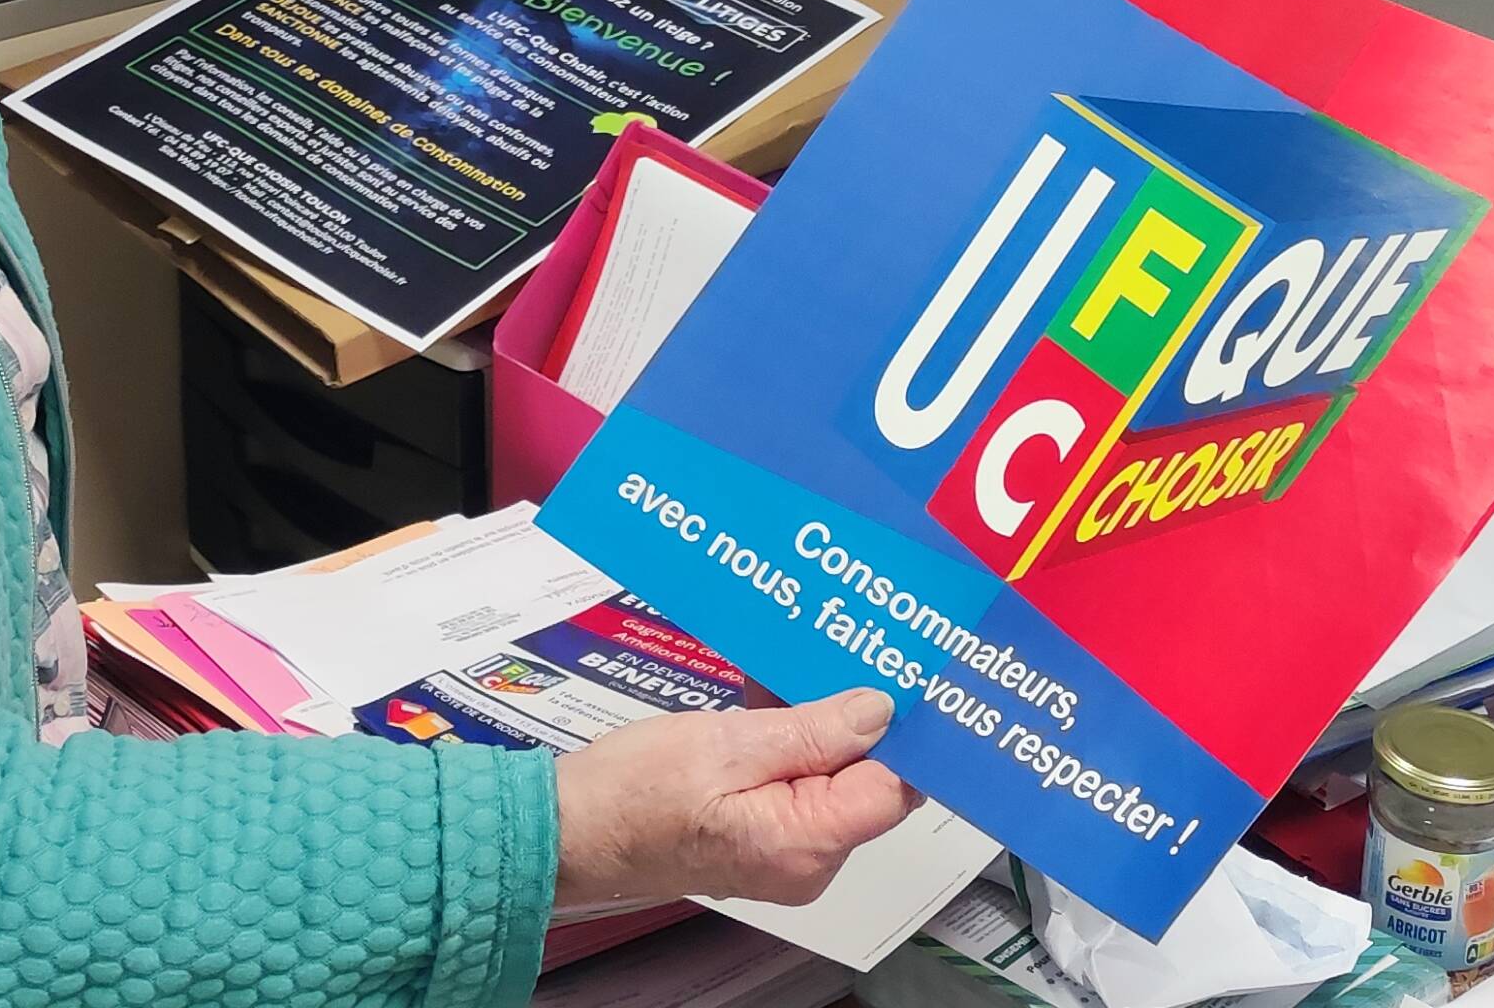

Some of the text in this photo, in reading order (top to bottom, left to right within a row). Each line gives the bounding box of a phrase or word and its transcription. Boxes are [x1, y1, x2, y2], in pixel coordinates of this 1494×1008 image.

[241, 11, 302, 47] trompeurs.
[361, 11, 382, 25] les
[379, 22, 440, 57] malfaçons
[438, 55, 456, 66] et
[452, 61, 474, 77] les
[470, 76, 514, 101] pièges
[511, 99, 530, 111] de
[528, 106, 544, 118] la
[390, 12, 431, 36] toutes
[428, 31, 449, 46] les
[447, 42, 491, 71] formes
[489, 69, 556, 110] d'arnaques,
[438, 3, 628, 108] au service des consommateurs
[628, 5, 655, 22] un
[653, 18, 701, 44] litige
[699, 41, 714, 51] ?
[108, 105, 146, 128] Contact
[150, 64, 195, 89] citoyens
[192, 86, 220, 102] dans
[217, 98, 243, 115] tous
[240, 111, 260, 125] les
[256, 122, 308, 156] domaines
[305, 151, 324, 165] de
[215, 23, 526, 201] Dans tous les domaines de consommation
[256, 2, 551, 170] SANCTIONNE les agissements déloyaux, abusifs ou
[320, 21, 341, 35] les
[336, 32, 396, 65] pratiques
[393, 62, 447, 95] abusives
[445, 93, 465, 108] ou
[459, 104, 490, 122] non
[487, 119, 554, 158] conformes,
[558, 52, 607, 84] Choisir,
[608, 80, 642, 99] c'est
[639, 94, 690, 121] l'action
[710, 70, 733, 86] !
[175, 48, 196, 61] Par
[254, 91, 274, 105] les
[314, 127, 345, 148] l'aide
[342, 146, 361, 158] ou
[357, 153, 371, 166] la
[366, 162, 398, 182] prise
[396, 179, 414, 191] en
[411, 188, 450, 212] charge
[447, 208, 466, 220] de
[463, 216, 486, 231] vos
[195, 74, 217, 87] nos
[214, 84, 270, 117] conseillers
[267, 114, 309, 141] experts
[306, 138, 323, 149] et
[315, 145, 359, 173] juristes
[356, 170, 385, 188] sont
[380, 185, 399, 197] au
[396, 194, 437, 219] service
[434, 216, 458, 231] des
[202, 130, 351, 225] UFC-QUE CHOISIR TOULON
[180, 133, 196, 143] de
[193, 139, 213, 153] Feu
[354, 238, 387, 261] Toulon
[1182, 227, 1450, 408] QUE
[1074, 420, 1307, 546] CHOISIR
[611, 632, 688, 663] Améliore
[687, 658, 717, 674] ton
[616, 651, 736, 699] EN DEVENANT
[617, 469, 710, 547] avec
[707, 528, 804, 622] nous,
[811, 594, 1003, 739] faites-vous
[1001, 718, 1176, 849] respecter
[1165, 815, 1203, 858] !
[621, 618, 697, 651] Gagne en
[793, 520, 1082, 732] Consommateurs,
[461, 705, 478, 719] DE
[475, 714, 494, 726] LA
[1387, 875, 1454, 907] Gerblé
[1387, 914, 1447, 945] ABRICOT
